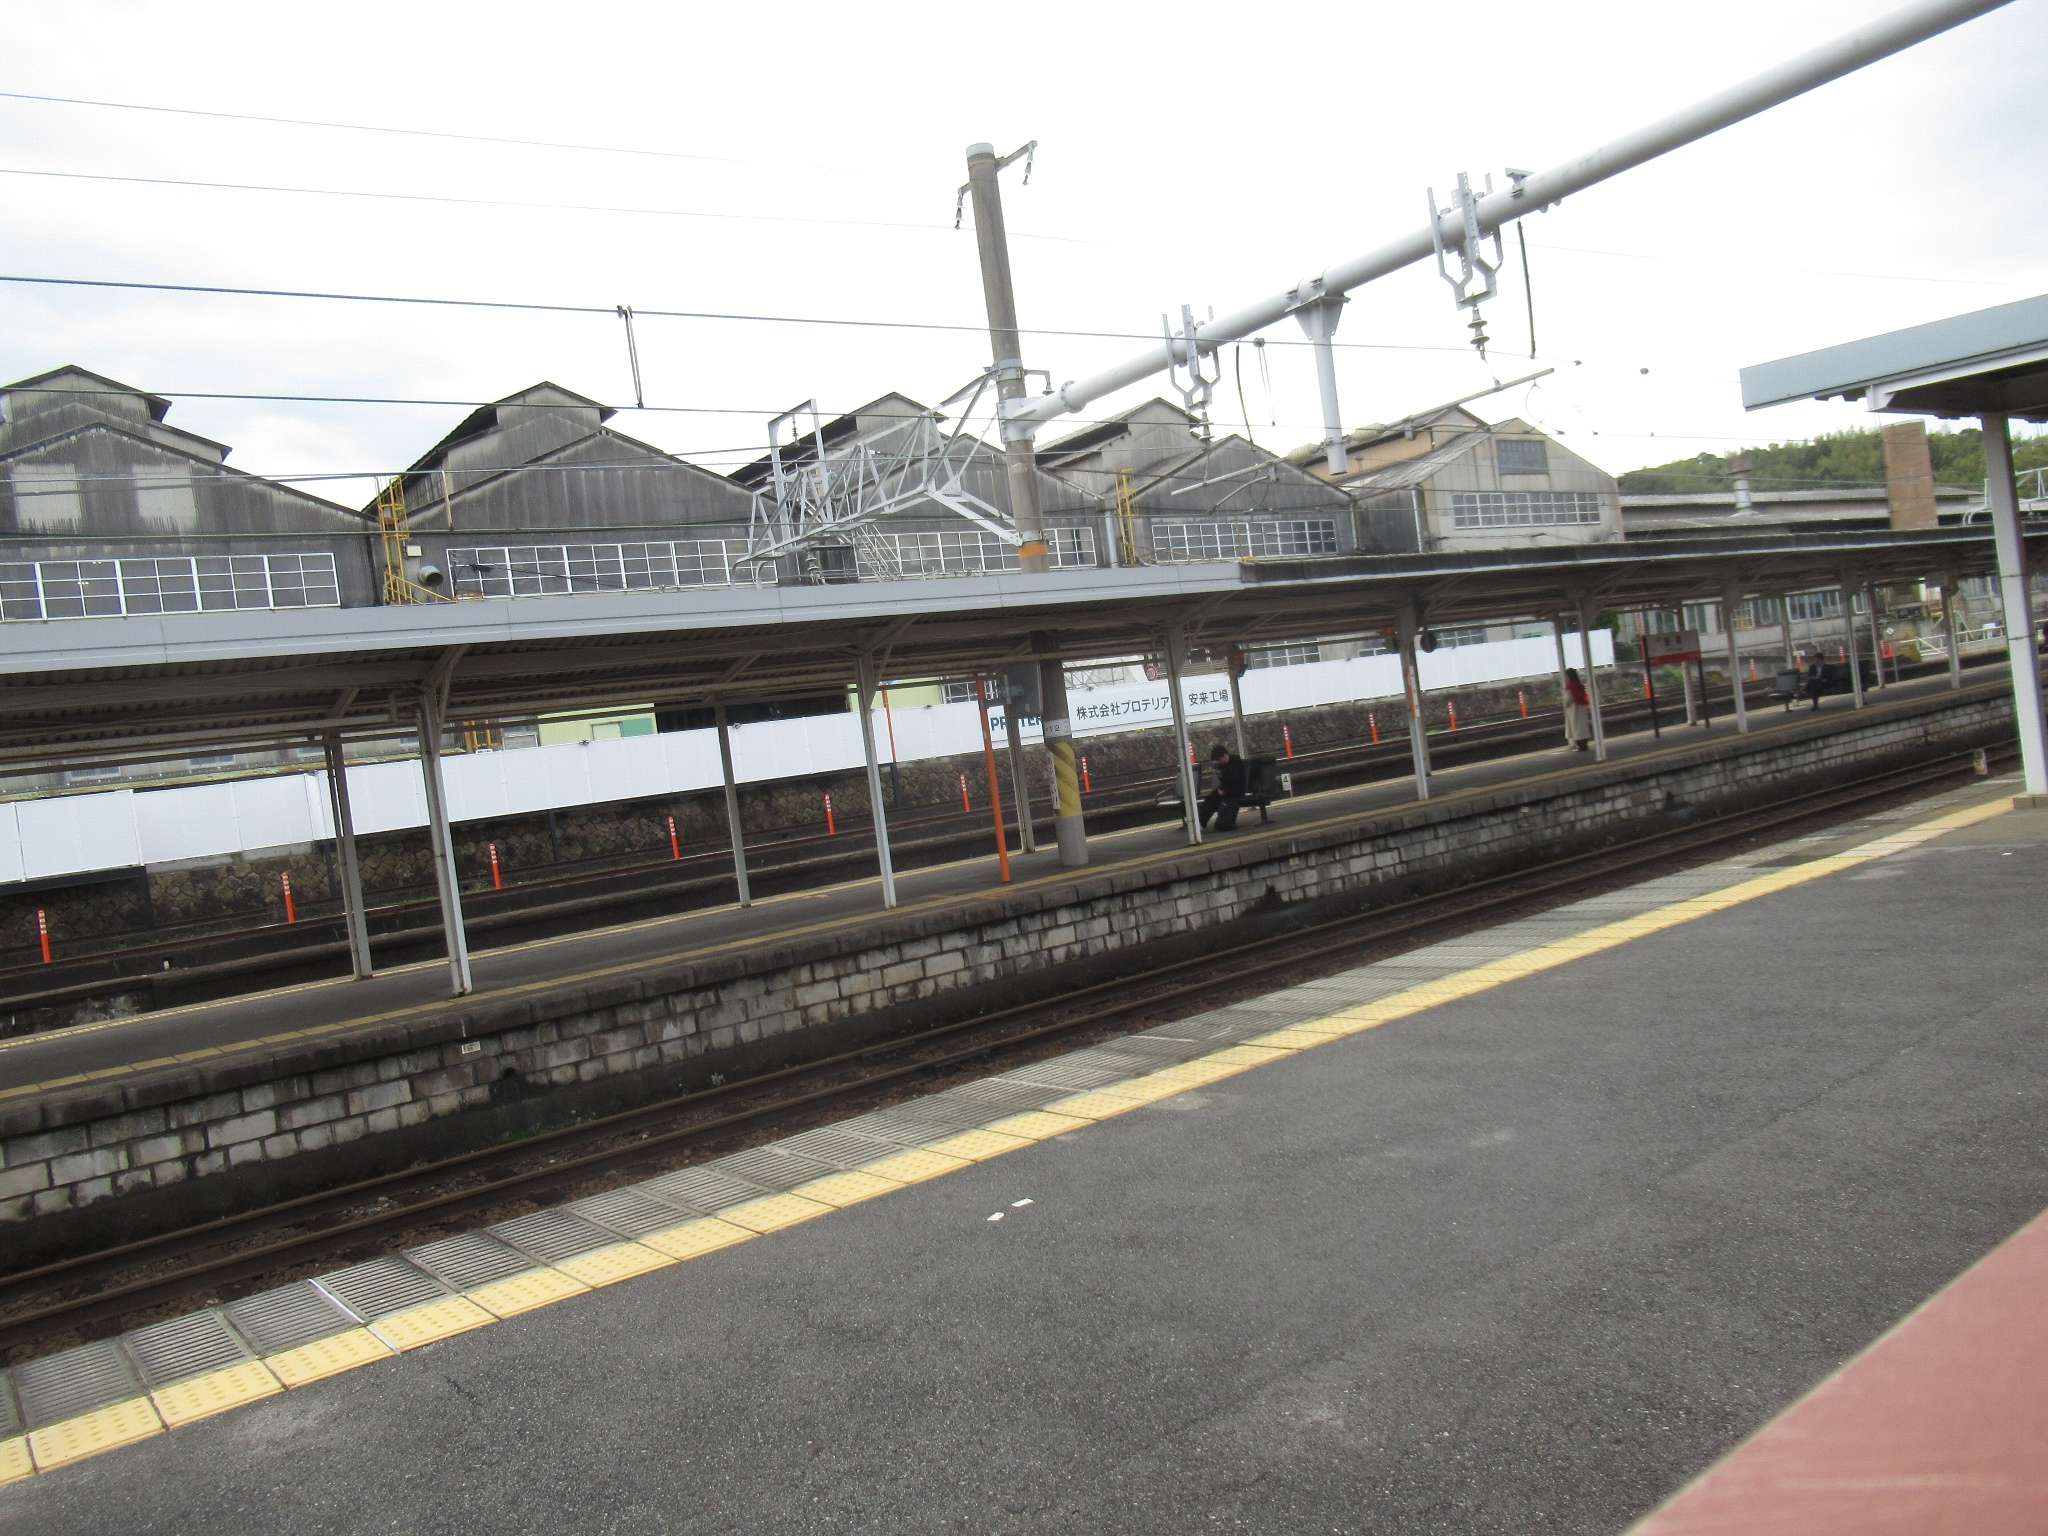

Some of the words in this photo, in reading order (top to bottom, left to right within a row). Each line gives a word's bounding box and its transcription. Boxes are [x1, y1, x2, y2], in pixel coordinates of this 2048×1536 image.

[1076, 696, 1170, 720] 株式会社プロテリア
[1188, 689, 1229, 706] 安来工場
